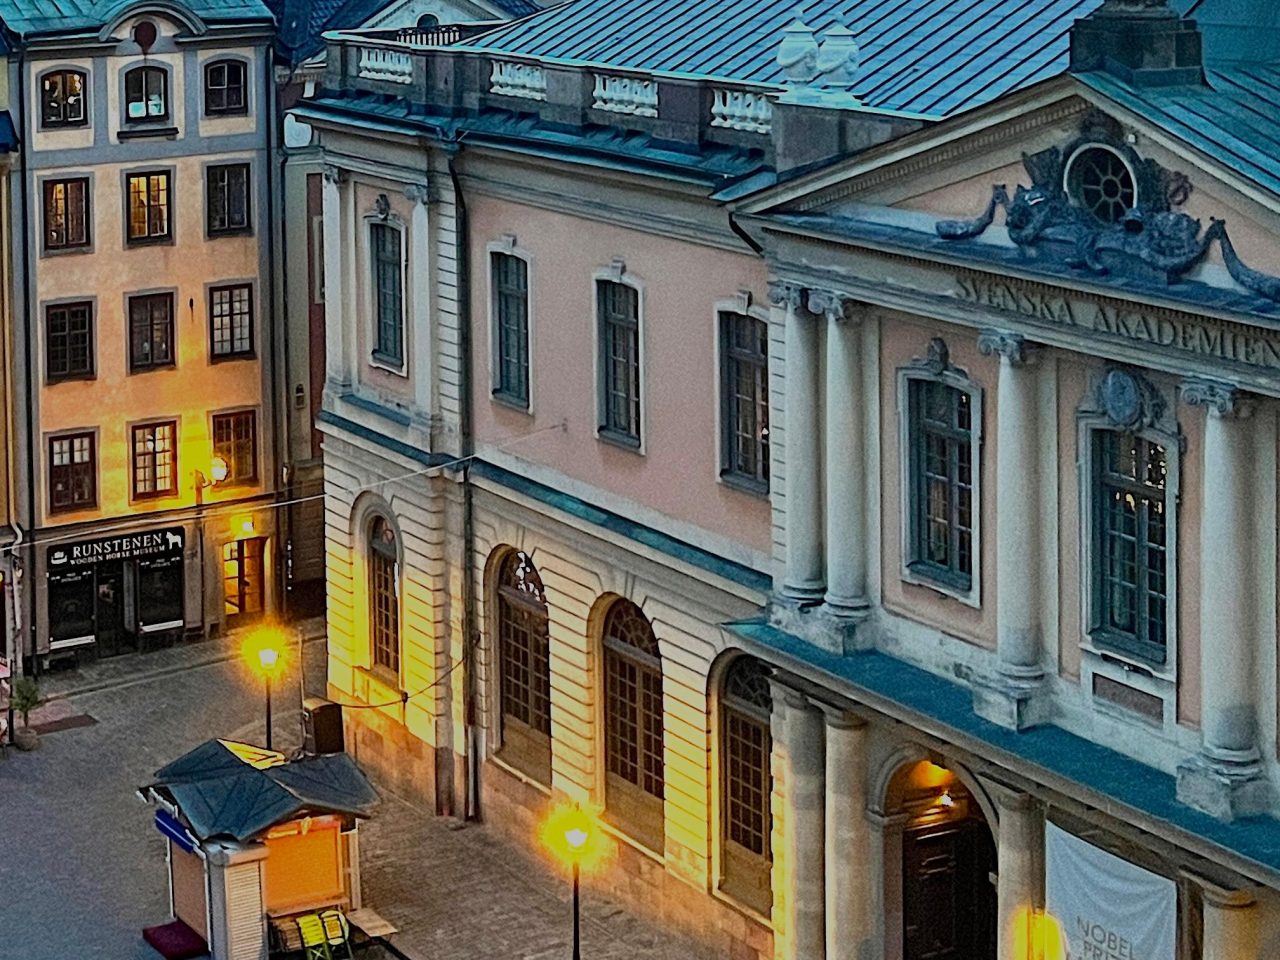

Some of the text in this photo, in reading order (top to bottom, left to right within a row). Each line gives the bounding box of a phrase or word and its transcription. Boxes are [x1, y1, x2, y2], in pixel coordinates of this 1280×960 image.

[955, 278, 1280, 366] SVENSKA AKADEMIEN
[69, 544, 166, 566] WOODEN HORSE MUSEUM
[73, 533, 162, 558] RUNSTENEN
[1076, 915, 1133, 960] NOBEL
